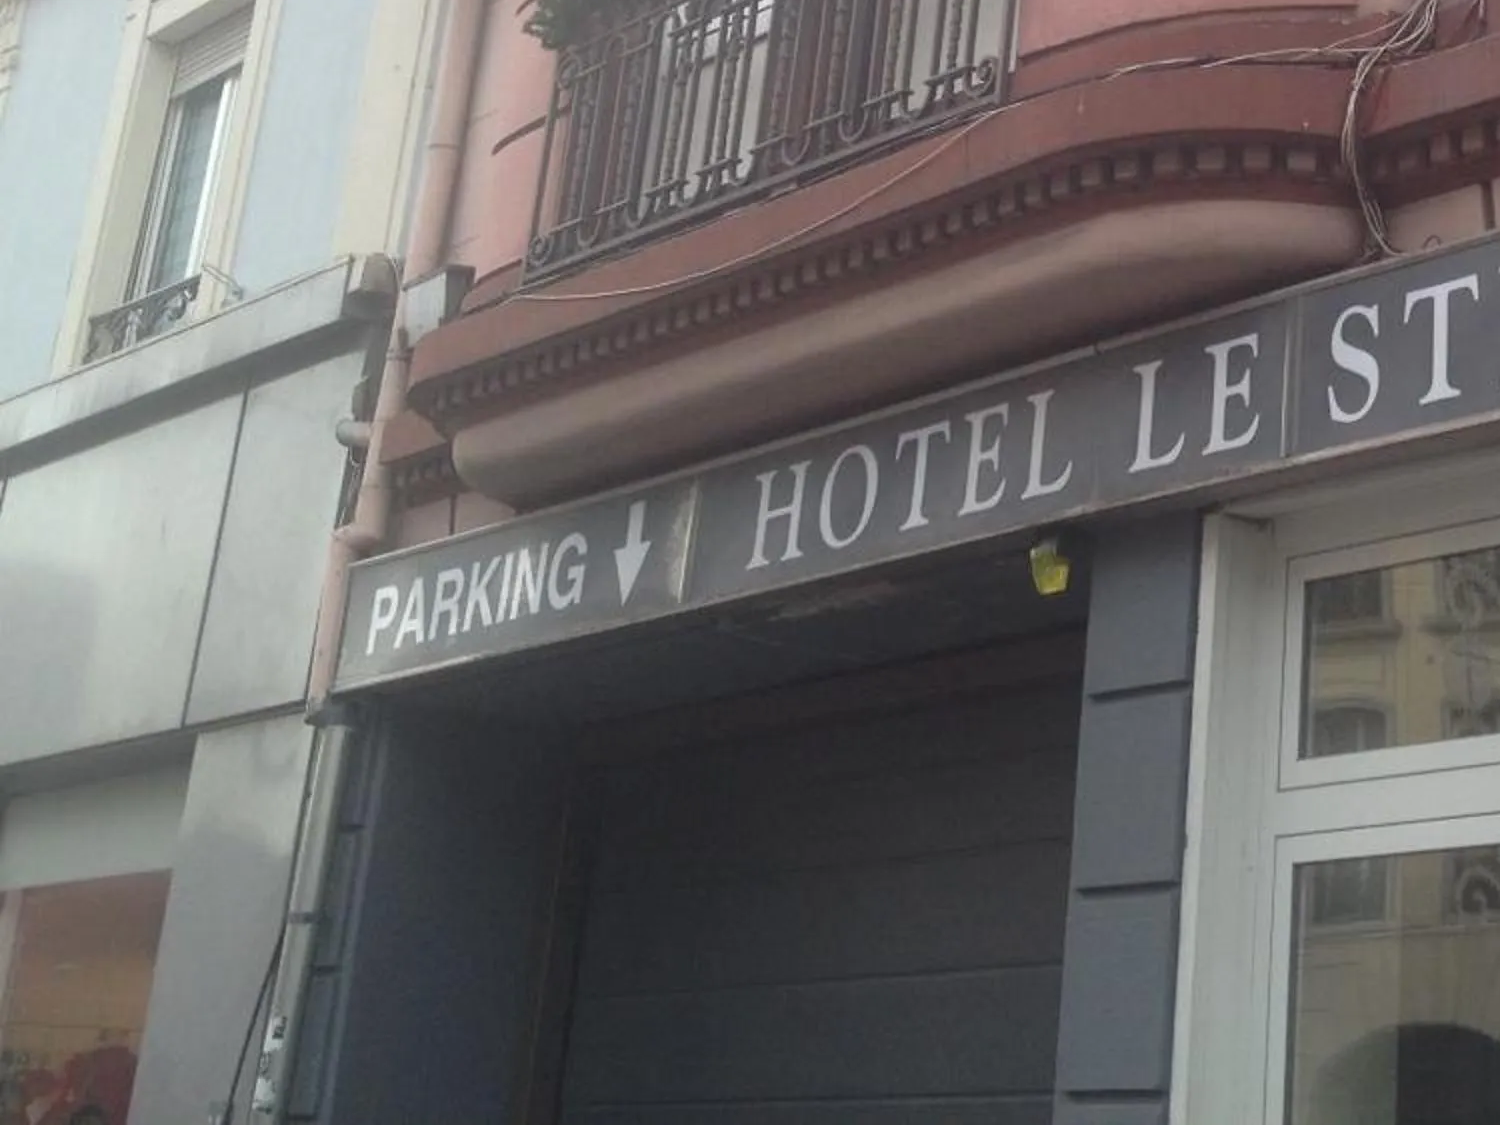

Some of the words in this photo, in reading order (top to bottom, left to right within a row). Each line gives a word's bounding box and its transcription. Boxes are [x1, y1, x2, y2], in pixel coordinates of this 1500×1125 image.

[744, 387, 1074, 572] HOTEL
[1127, 331, 1261, 476] LE
[365, 531, 588, 655] PARKING
